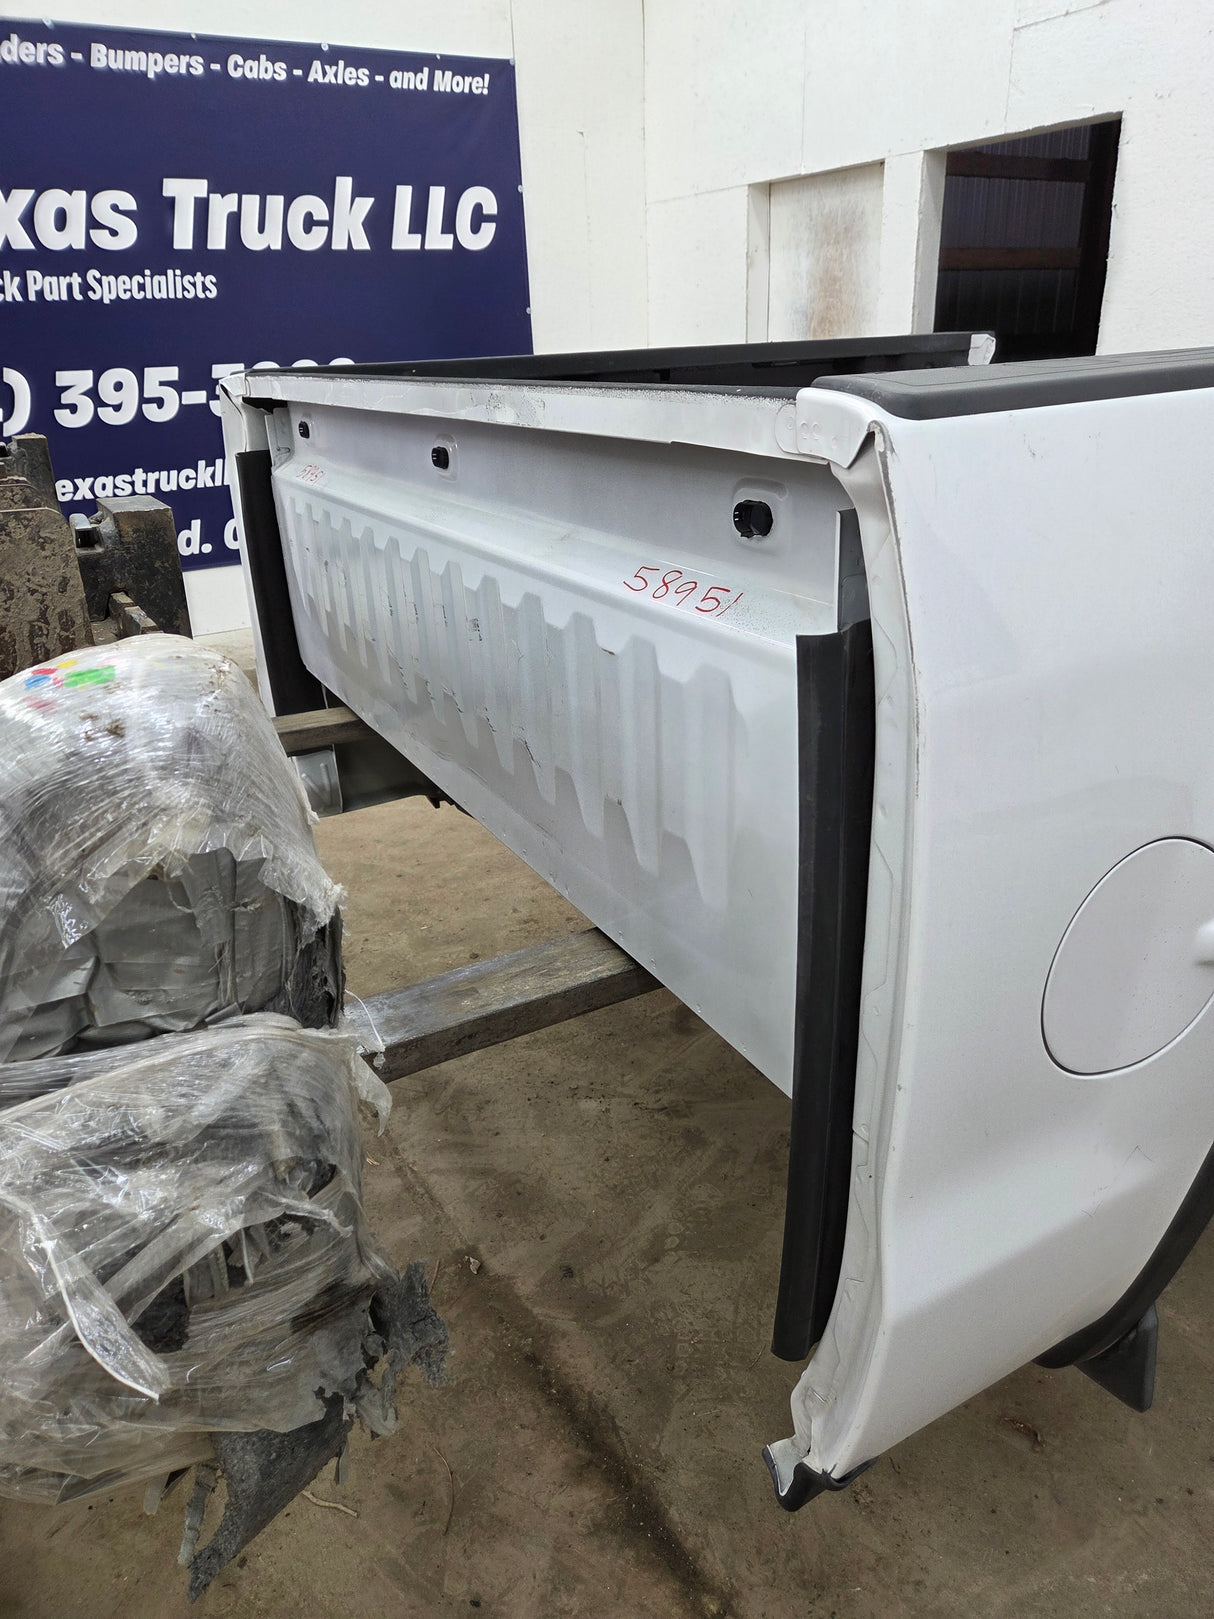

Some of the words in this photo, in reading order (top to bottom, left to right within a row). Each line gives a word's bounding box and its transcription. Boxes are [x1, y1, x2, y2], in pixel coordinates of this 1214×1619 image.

[0, 33, 64, 65] ders
[90, 42, 204, 79] Bumpers
[227, 54, 287, 81] Cabs
[307, 60, 370, 87] Axles
[389, 67, 429, 91] and
[433, 69, 490, 95] More!
[0, 188, 138, 251] xas
[162, 176, 375, 251] Truck
[391, 185, 498, 251] LLC
[0, 270, 23, 302] k
[26, 269, 83, 301] Part
[86, 268, 218, 304] Specialists
[623, 566, 744, 618] 58951
